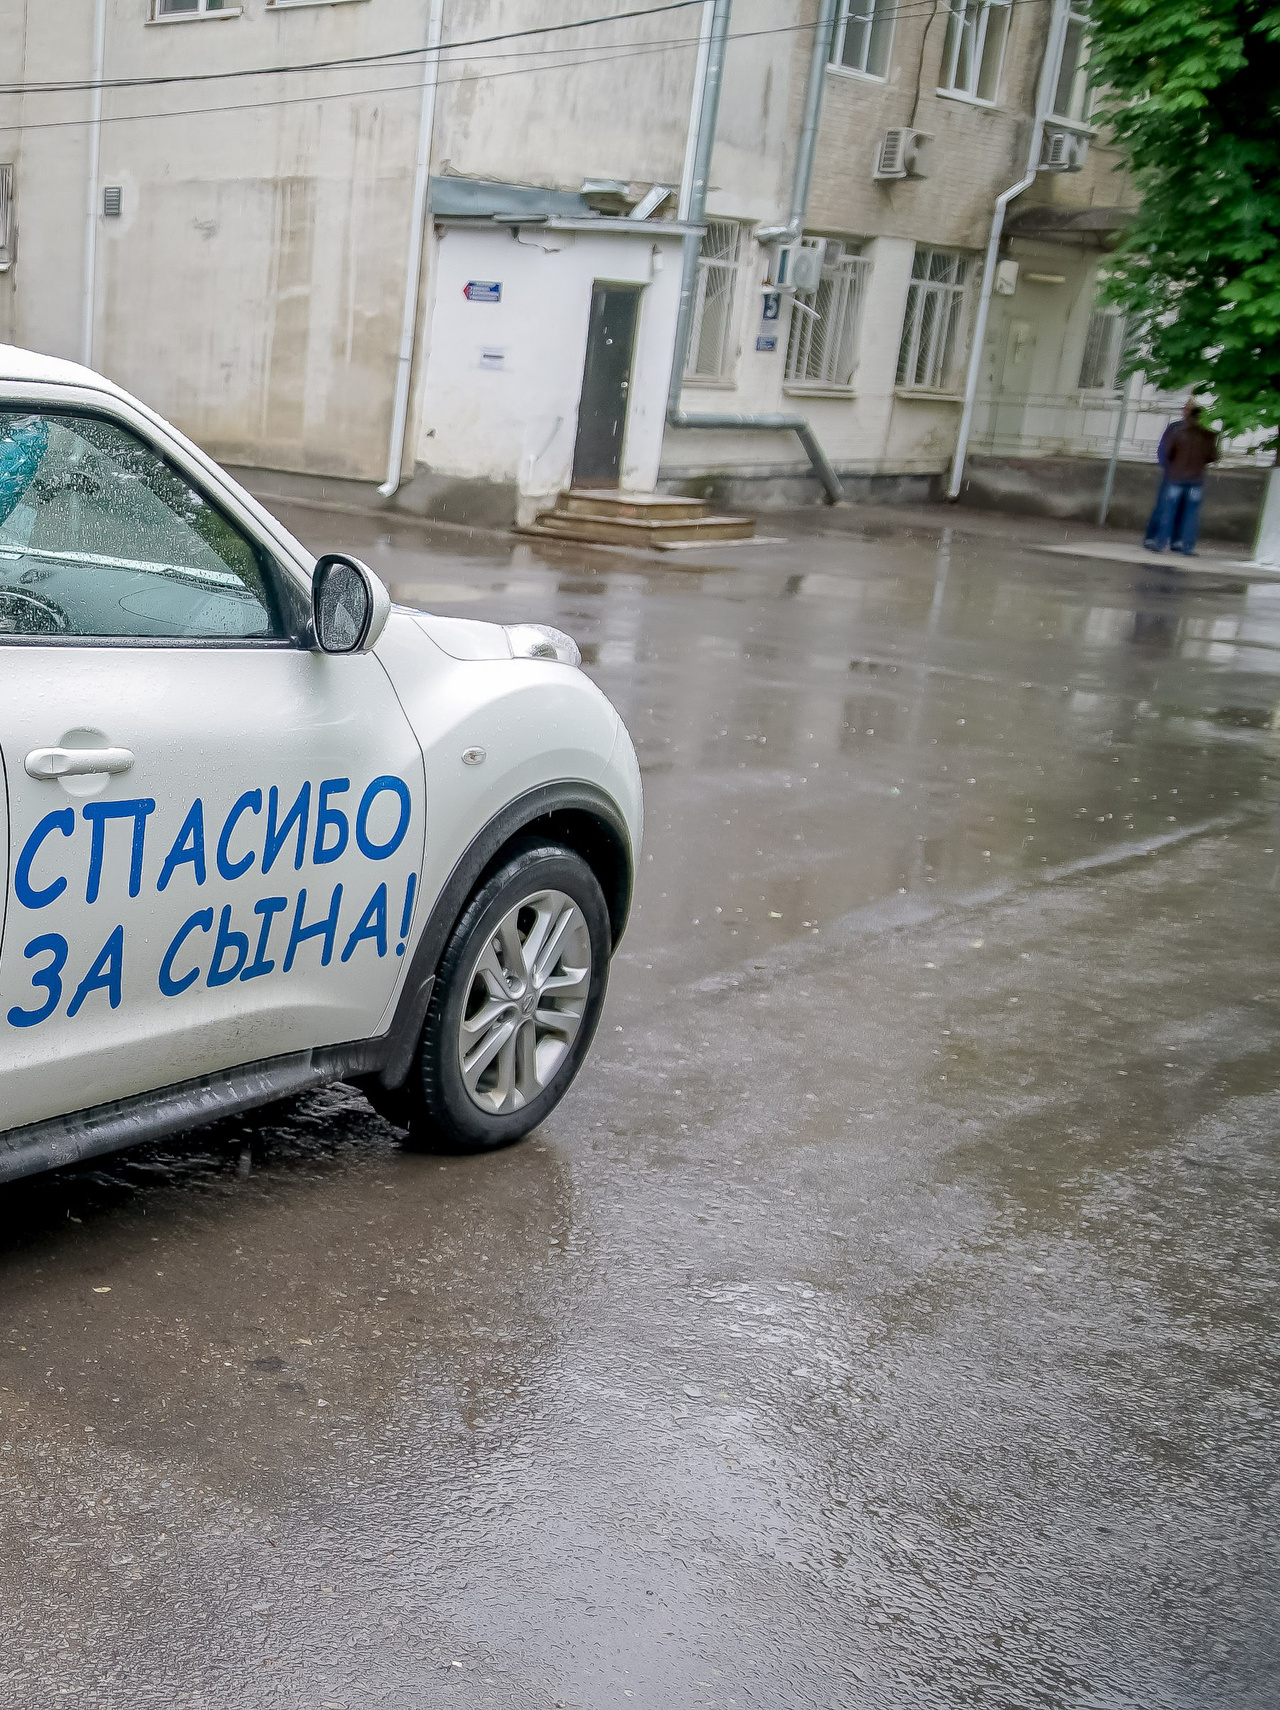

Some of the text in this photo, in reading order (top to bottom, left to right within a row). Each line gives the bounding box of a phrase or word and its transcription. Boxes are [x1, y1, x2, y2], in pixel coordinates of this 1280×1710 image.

[15, 776, 411, 909] СПАСИБО
[8, 873, 417, 1028] ЗА СЫНА!
